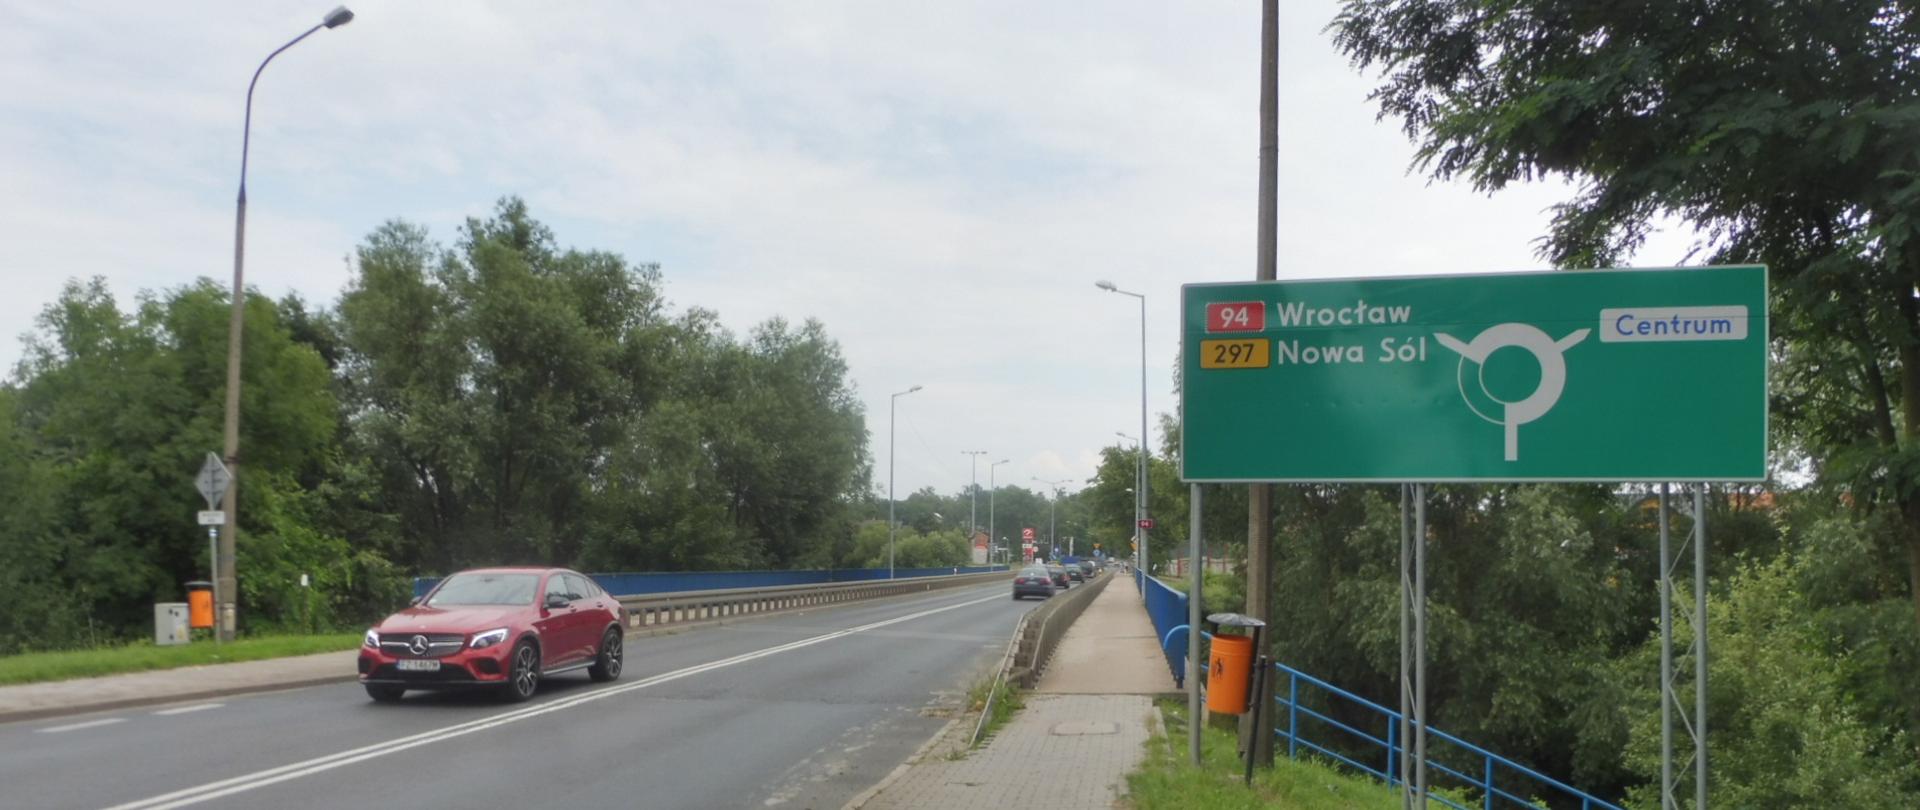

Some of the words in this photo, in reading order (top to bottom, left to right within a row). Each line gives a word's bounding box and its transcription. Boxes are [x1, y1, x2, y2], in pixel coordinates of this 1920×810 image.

[1220, 306, 1249, 328] 94
[1277, 300, 1411, 327] Wrocław
[1616, 314, 1731, 336] Centrum
[1214, 343, 1255, 364] 297
[1278, 340, 1364, 365] Nowa
[1379, 336, 1426, 363] Sól
